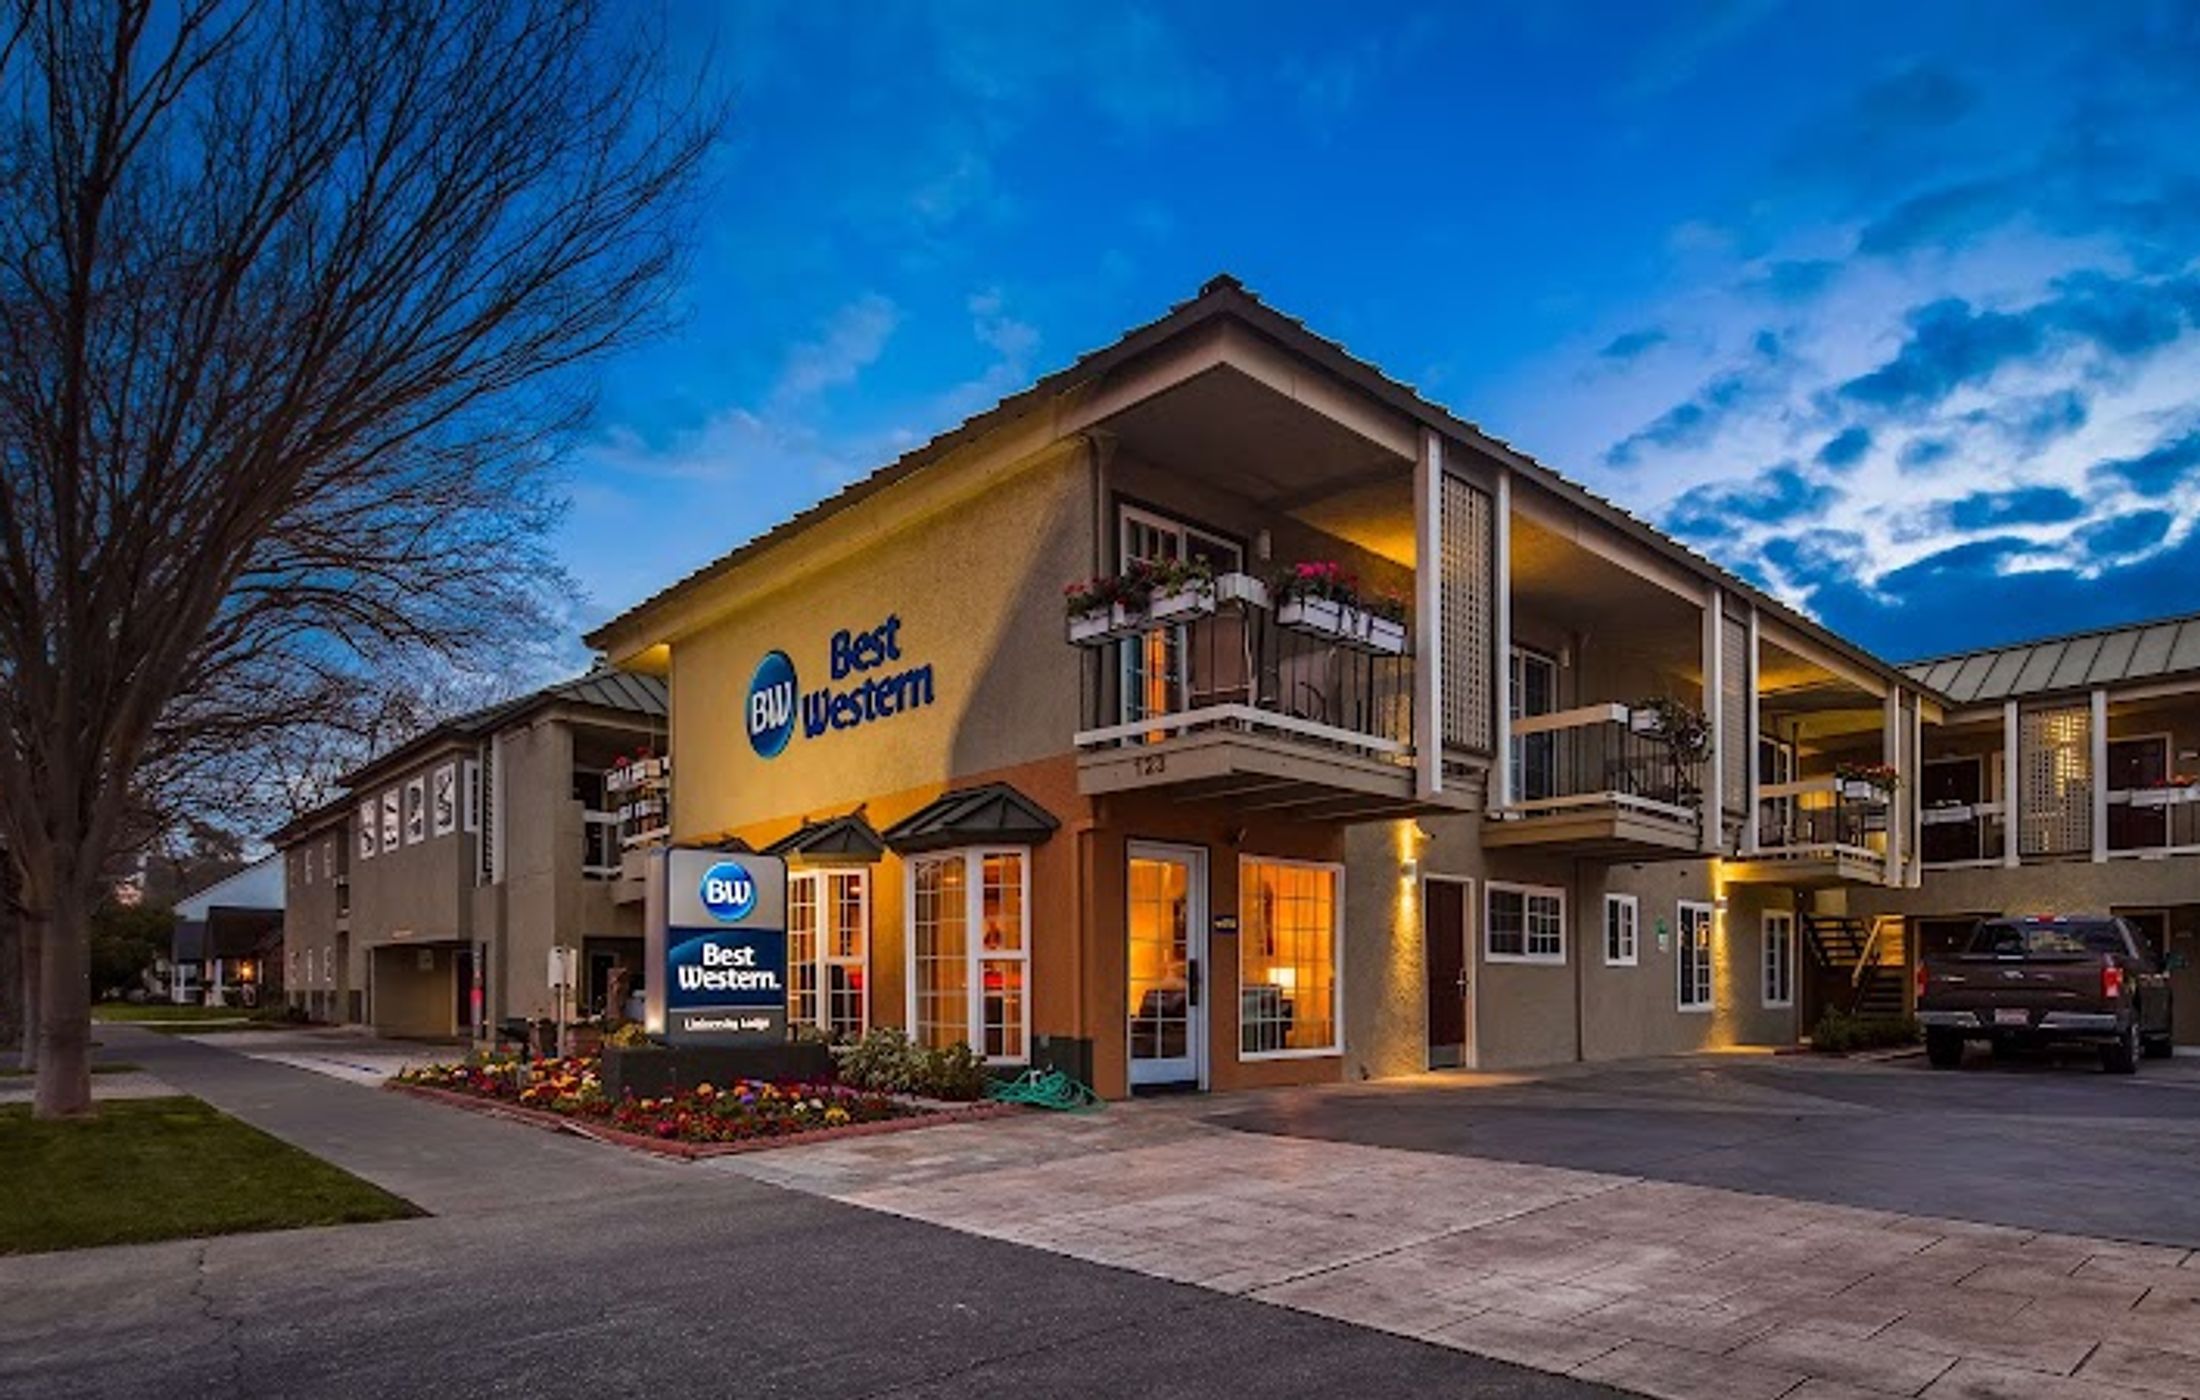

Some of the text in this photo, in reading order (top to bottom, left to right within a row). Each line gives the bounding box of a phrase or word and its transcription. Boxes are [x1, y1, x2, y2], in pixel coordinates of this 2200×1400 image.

[830, 613, 901, 680] Best
[752, 681, 792, 735] BW
[802, 664, 935, 738] Western
[1134, 754, 1165, 776] 123
[707, 878, 750, 904] BW
[703, 943, 755, 966] Best
